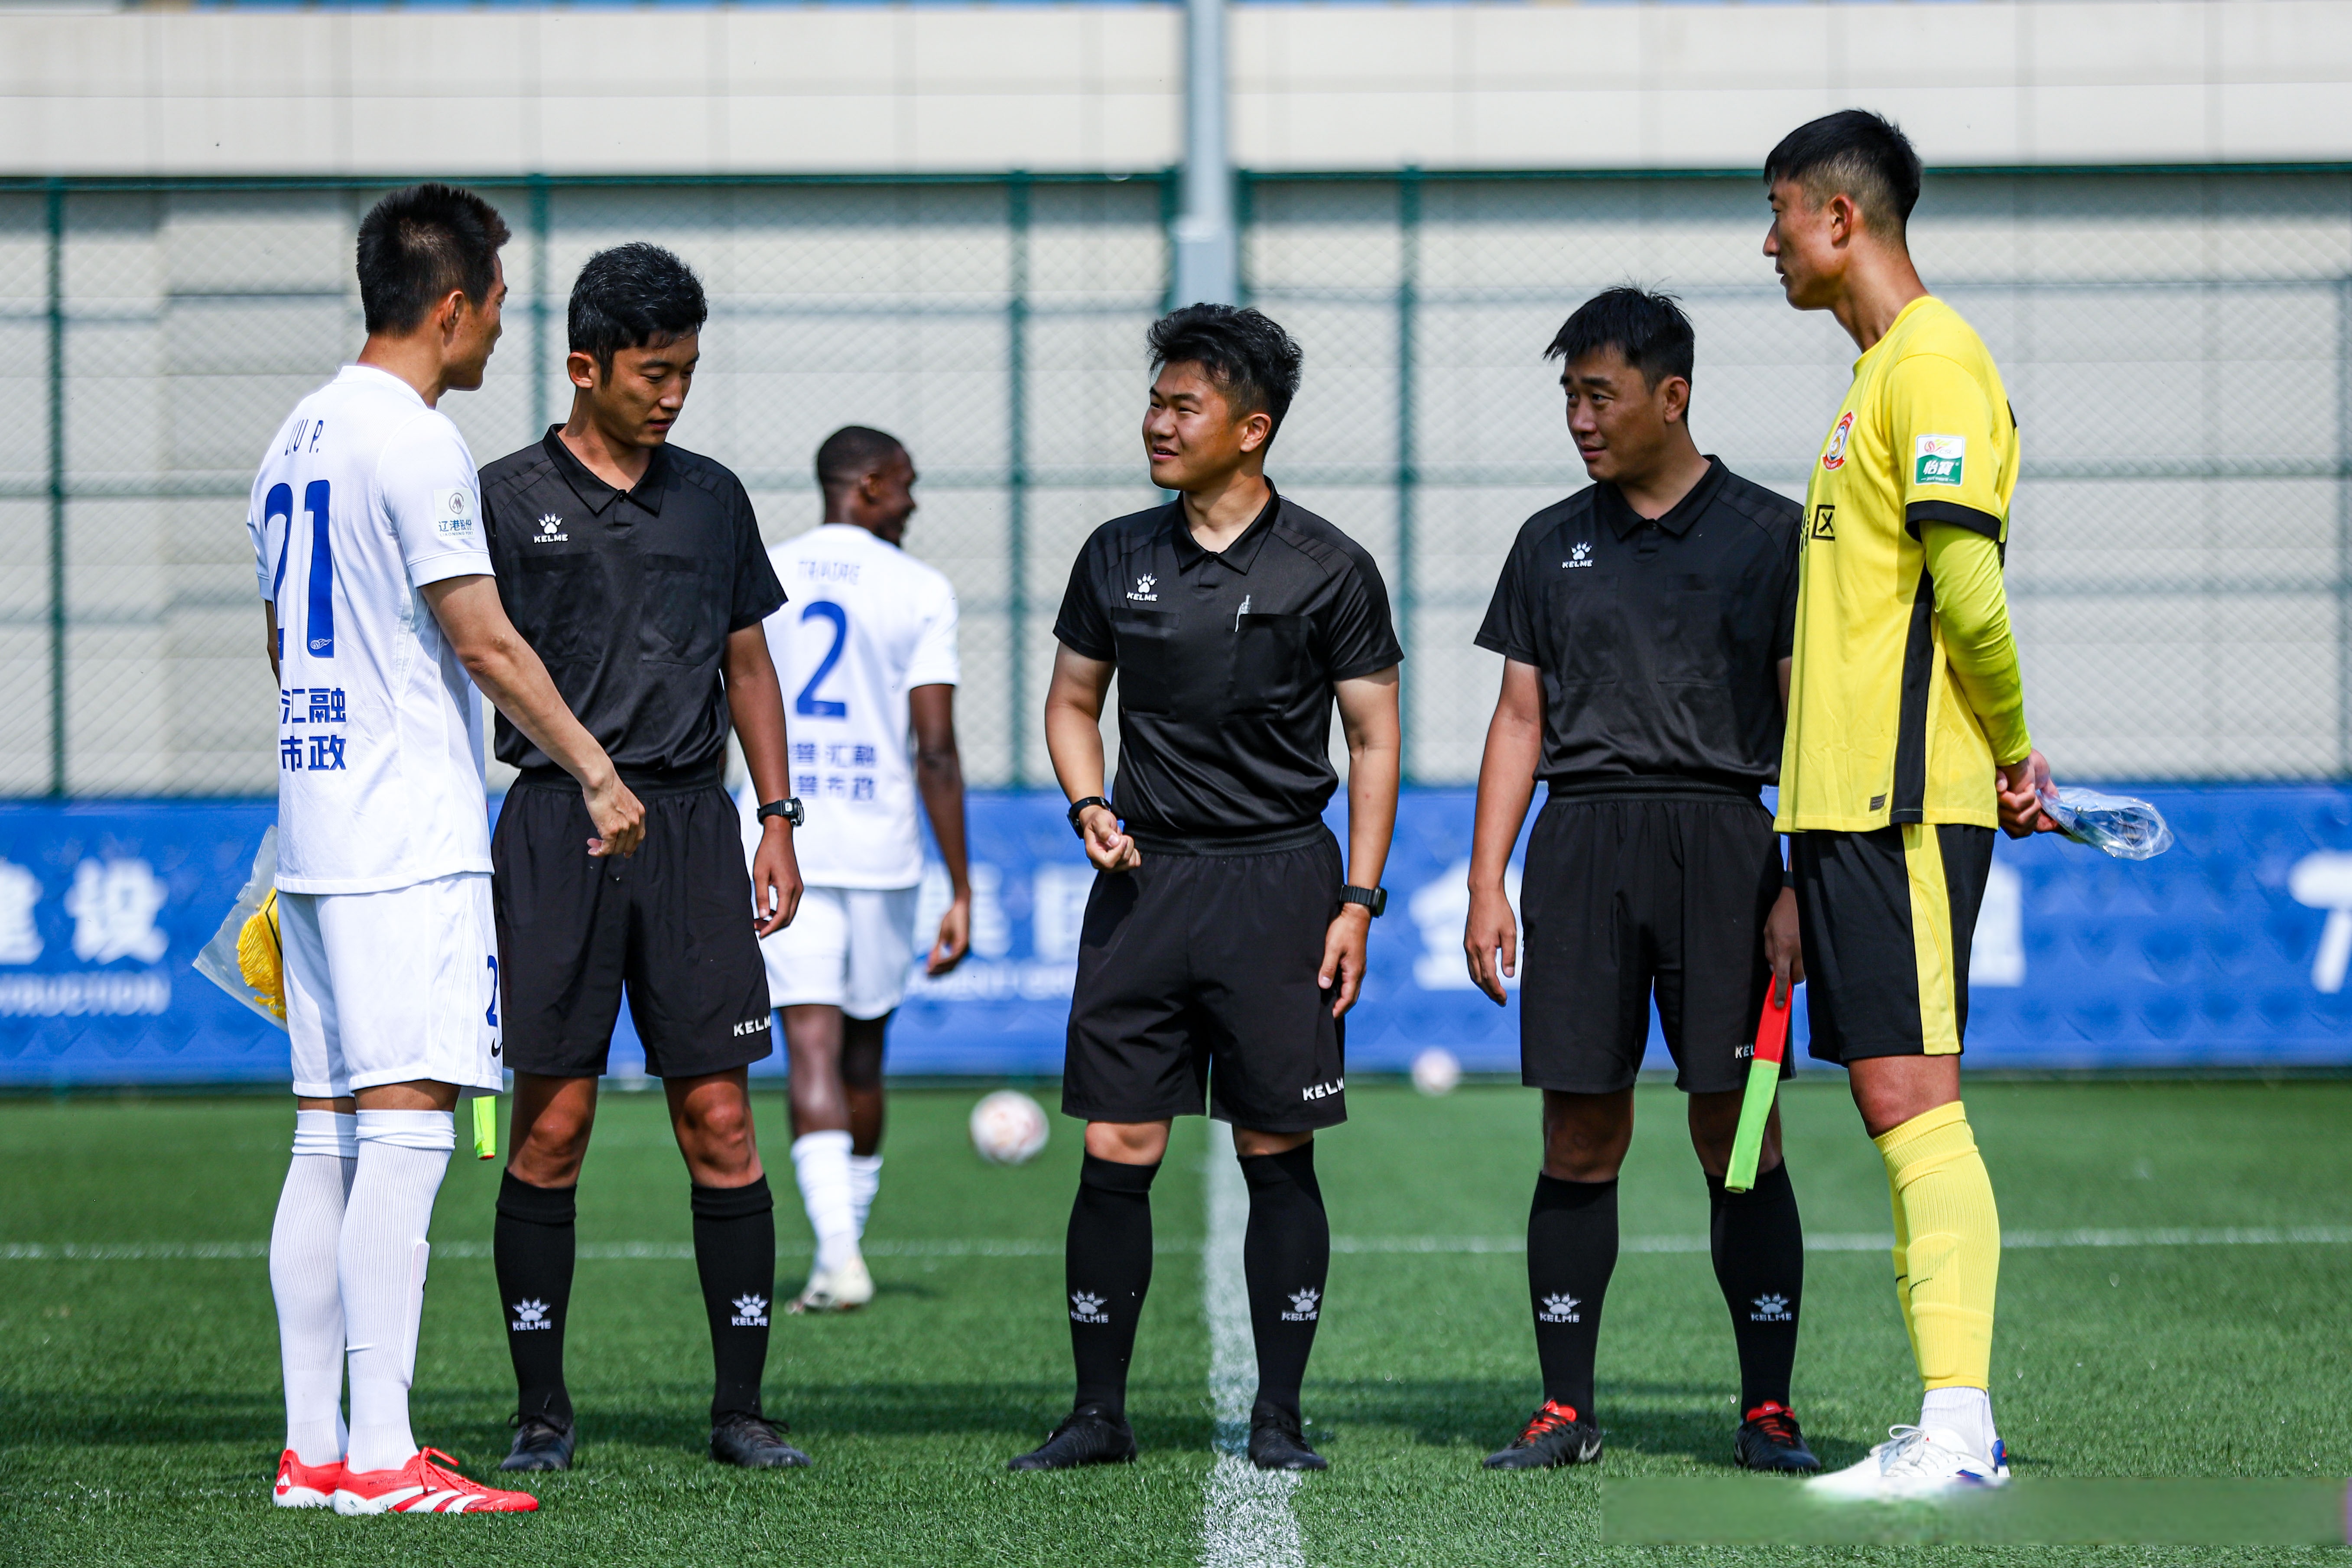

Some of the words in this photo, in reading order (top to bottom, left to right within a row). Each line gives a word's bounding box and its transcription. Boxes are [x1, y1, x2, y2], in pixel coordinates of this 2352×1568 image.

[309, 420, 324, 454] P.
[439, 519, 472, 532] 辽港股份
[534, 534, 568, 543] KELME
[1562, 559, 1593, 568] KELME
[265, 480, 335, 660] 21
[1127, 592, 1158, 601] KELME
[796, 601, 848, 718] 2
[281, 735, 346, 772] 市政
[486, 955, 498, 1027] 2
[731, 1316, 768, 1327] KELME
[1070, 1310, 1109, 1323] KELME
[1539, 1312, 1580, 1323] KELME
[1751, 1313, 1792, 1321] KELME
[513, 1319, 551, 1331] KELME
